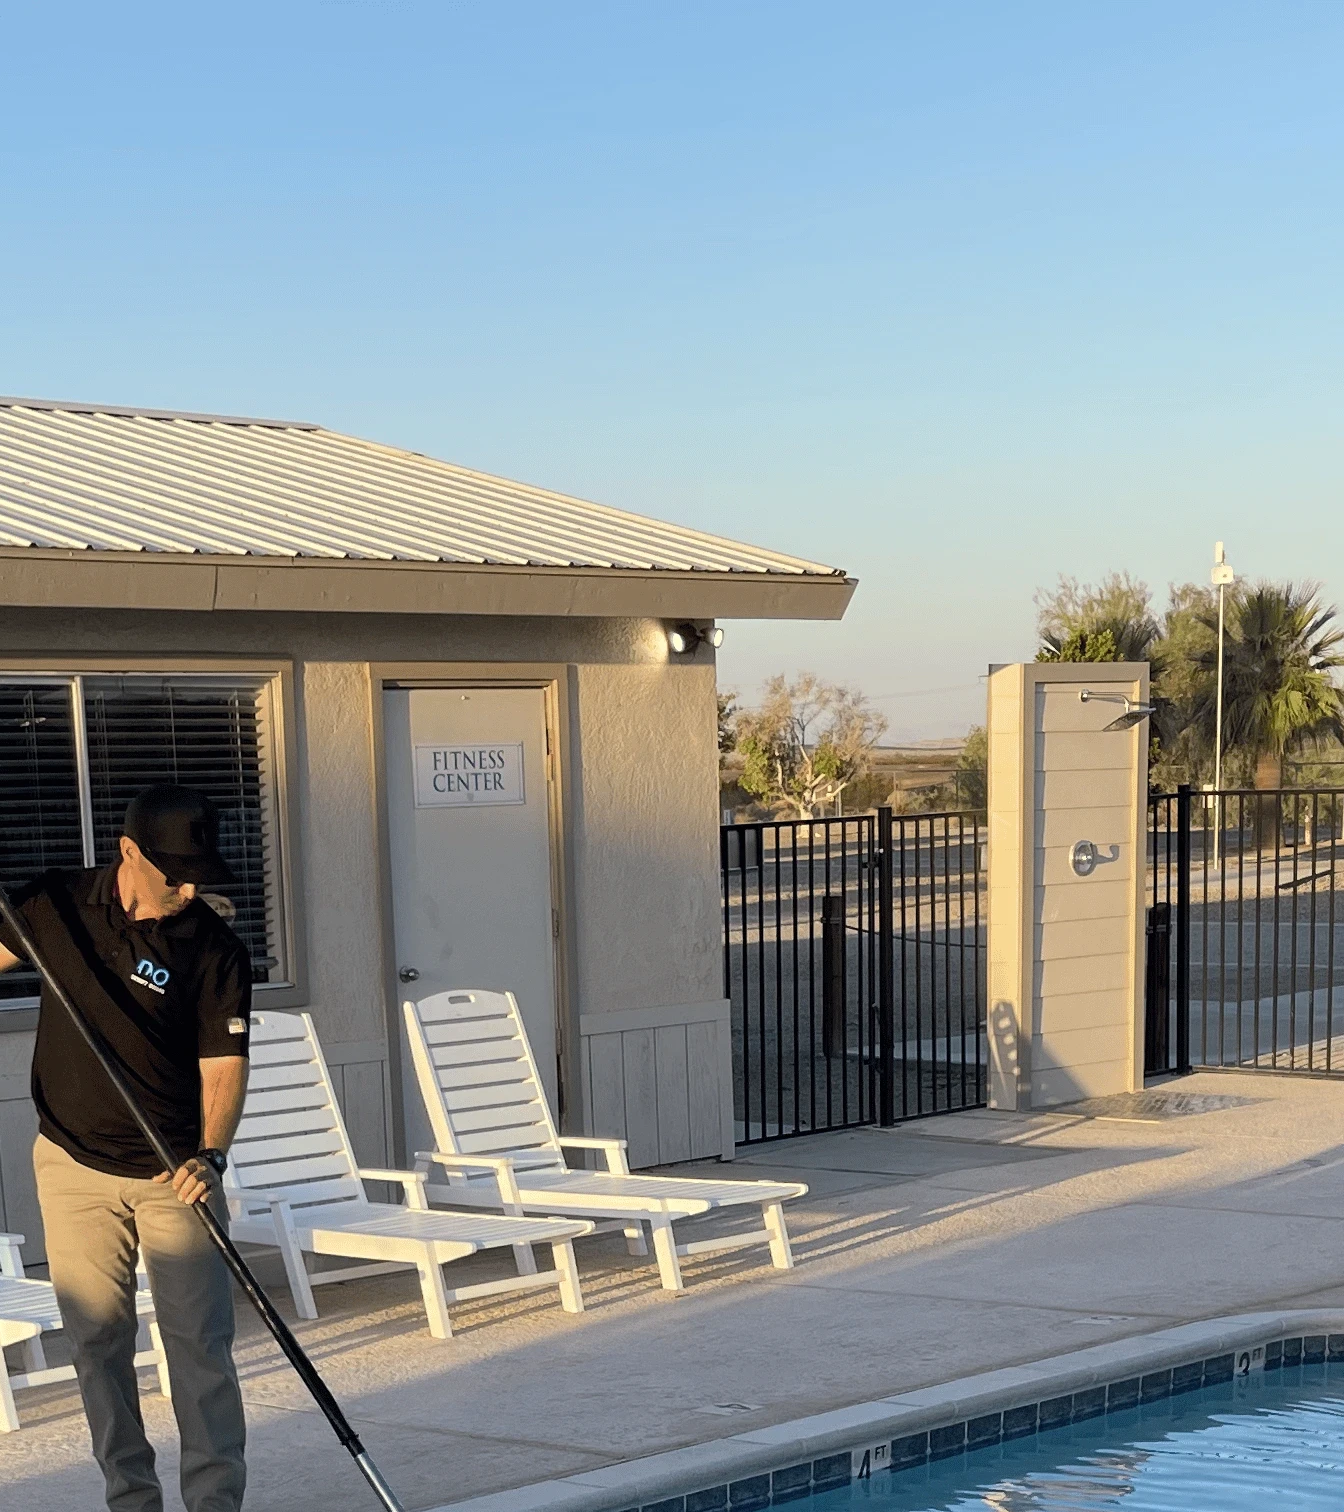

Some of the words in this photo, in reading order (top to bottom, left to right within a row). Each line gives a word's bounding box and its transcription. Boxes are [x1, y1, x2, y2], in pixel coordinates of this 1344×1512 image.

[432, 750, 505, 770] FITNESS
[433, 772, 505, 793] CENTER
[874, 1445, 887, 1461] FT
